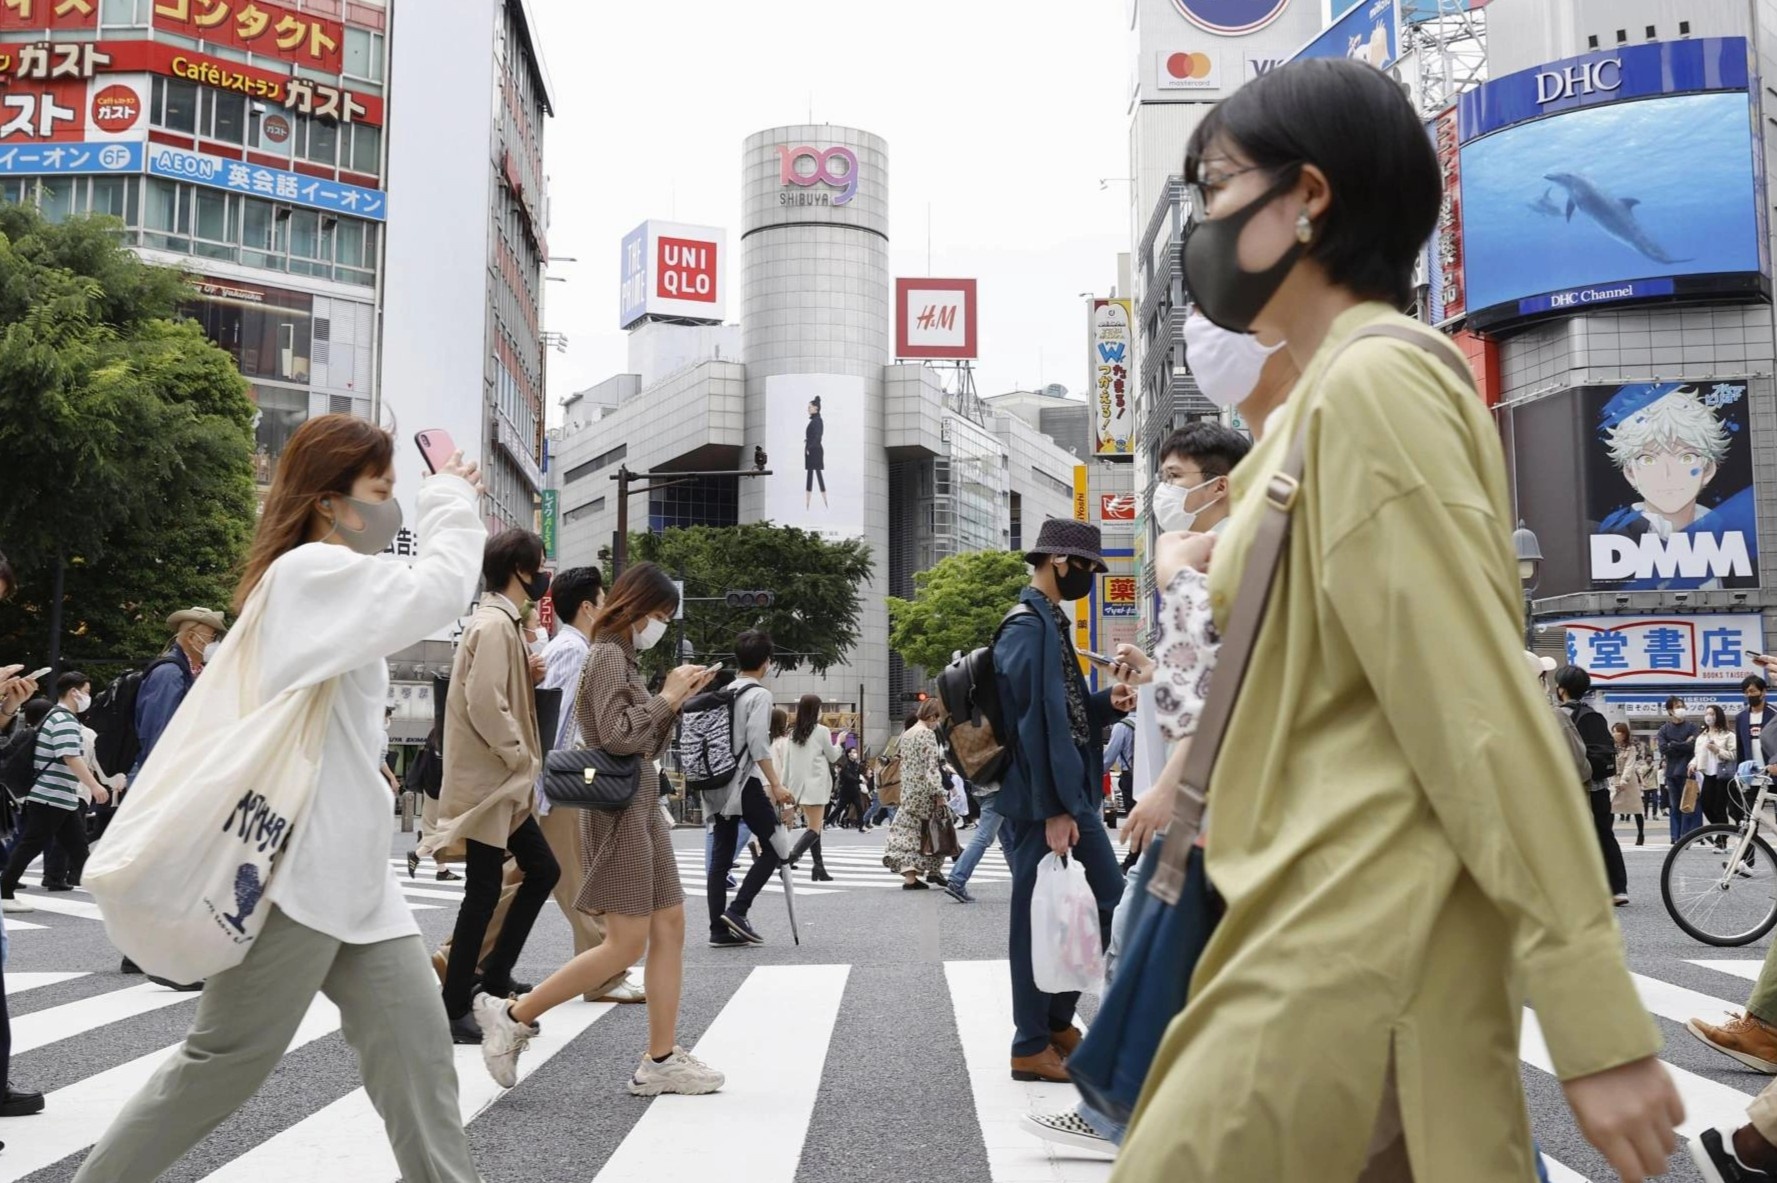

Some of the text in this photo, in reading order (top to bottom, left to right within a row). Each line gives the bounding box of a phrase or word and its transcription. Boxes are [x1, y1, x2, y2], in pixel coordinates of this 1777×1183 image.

[17, 43, 109, 77] ガスト
[1247, 59, 1285, 77] VI
[1534, 57, 1622, 104] DHC
[98, 105, 136, 119] ガスト
[286, 80, 366, 122] ガスト
[0, 147, 127, 170] イーオン 6F
[158, 151, 214, 179] AEON
[775, 145, 858, 205] 109
[779, 193, 829, 206] SHIBUYA
[664, 244, 706, 270] UNI
[664, 270, 711, 296] QLO
[1551, 285, 1633, 307] DHC Channel
[916, 305, 957, 331] H&M
[1590, 531, 1753, 580] DMM
[1110, 578, 1135, 601] 薬
[1702, 671, 1724, 679] BOOKS
